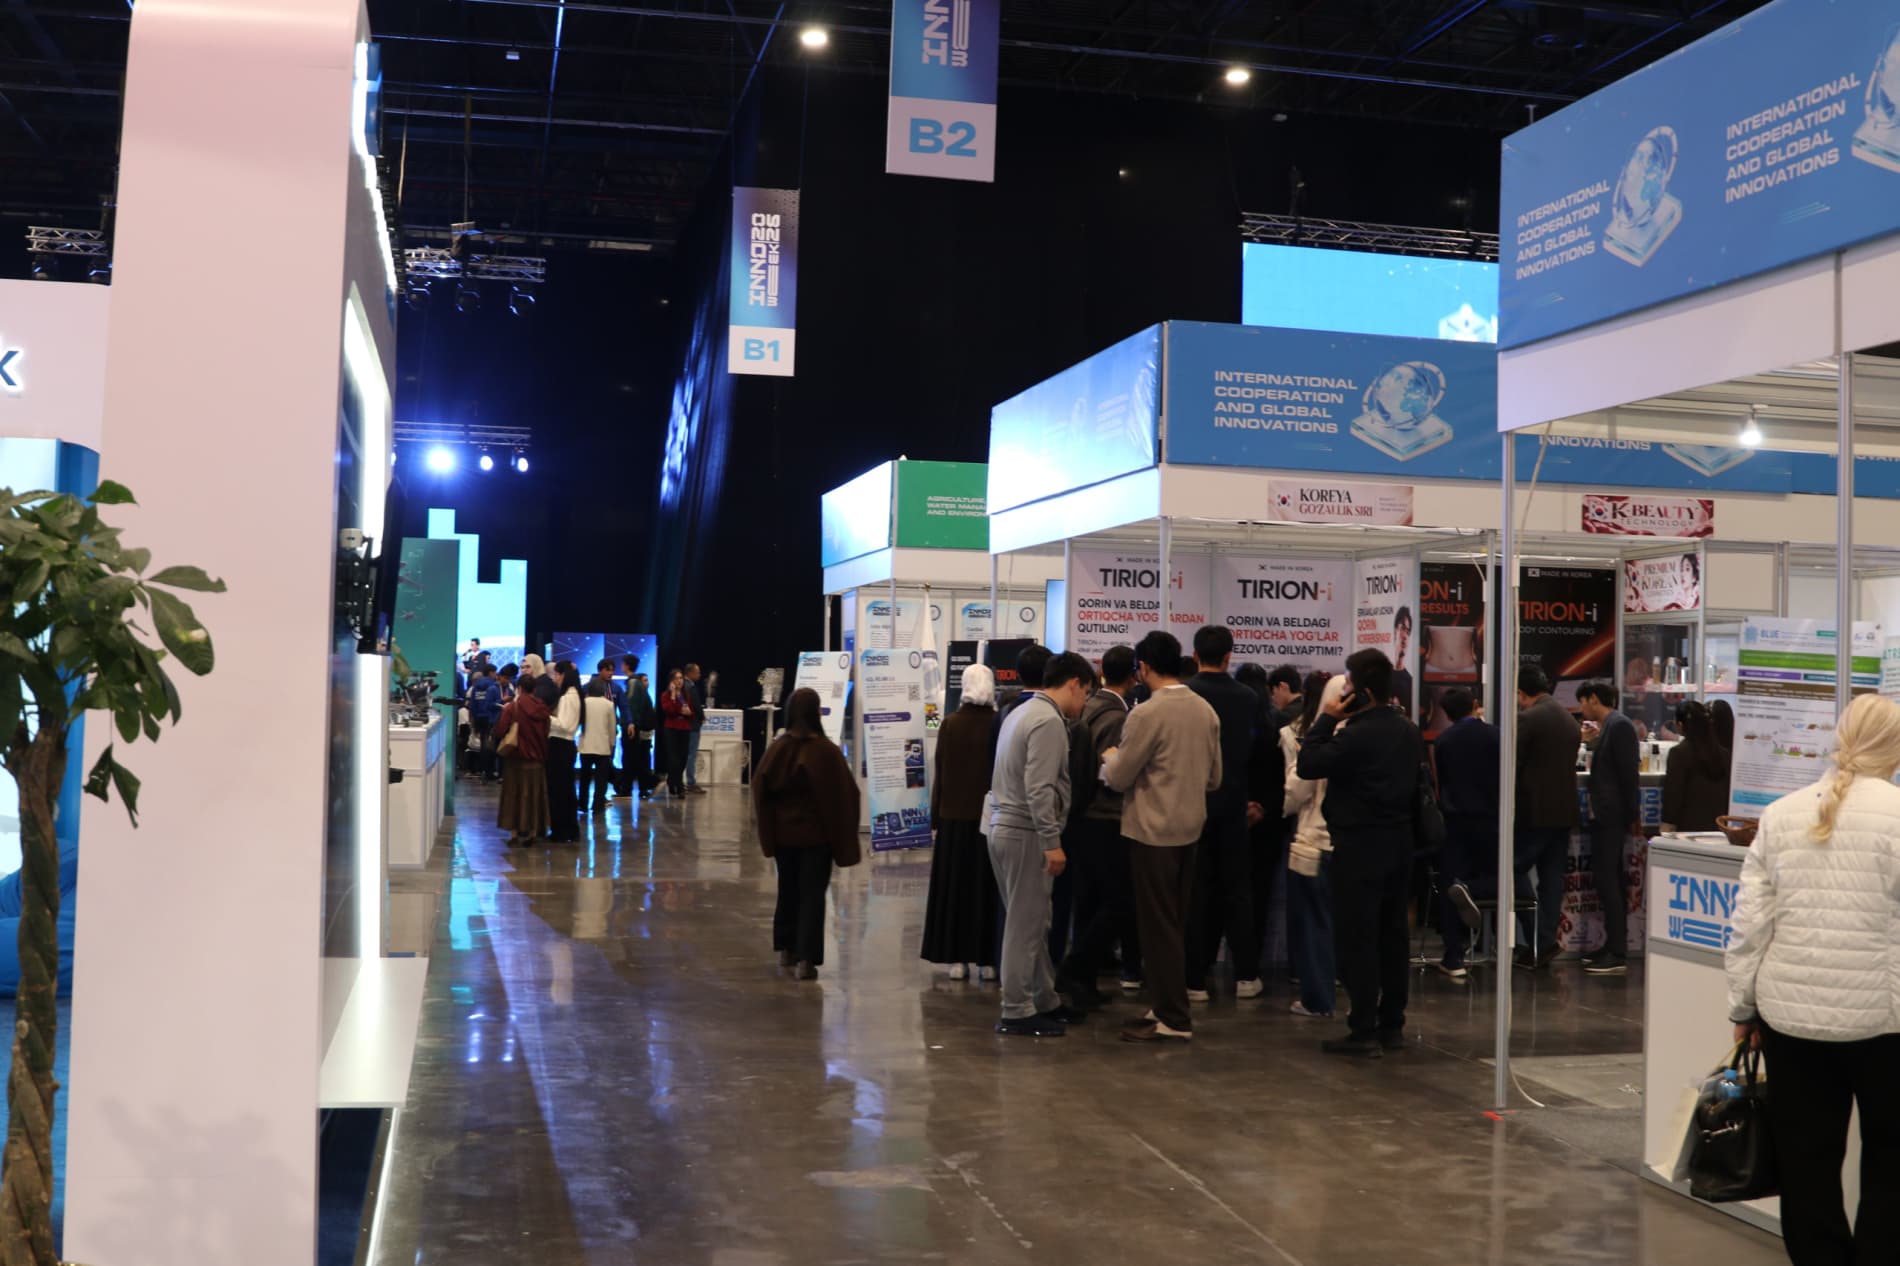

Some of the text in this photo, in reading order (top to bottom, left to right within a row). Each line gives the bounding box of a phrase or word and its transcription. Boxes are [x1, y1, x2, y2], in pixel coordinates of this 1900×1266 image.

[1727, 72, 1861, 140] INTERNATIONAL
[908, 117, 977, 158] B2
[1726, 99, 1846, 161] COOPERATION
[1726, 129, 1834, 182] AND GLOBAL
[1725, 147, 1839, 204] INNOVATIONS
[1517, 179, 1610, 228] INTERNATIONAL
[1518, 201, 1600, 245] COOPERATION
[1516, 224, 1592, 263] AND GLOBAL
[1516, 240, 1595, 280] INNOVATIONS
[744, 338, 780, 362] B1
[1214, 371, 1358, 390] INTERNATIONAL
[1214, 386, 1344, 404] COOPERATION
[1214, 401, 1332, 418] AND GLOBAL
[1214, 416, 1339, 434] INNOVATIONS
[1355, 506, 1373, 517] SIRI
[1612, 503, 1697, 520] K-BEAUTY
[1620, 518, 1694, 527] TECHNOLOGY
[1099, 568, 1182, 589] TIRIO-i
[1366, 574, 1402, 595] TIRION-i
[1237, 579, 1332, 601] TIRION-i
[1078, 599, 1172, 610] QORIN VA BELDAI
[1420, 603, 1470, 615] RESULTS
[1078, 611, 1134, 621] ORTIQCHA
[1226, 616, 1330, 628] QORIN VA BELDAGI
[1077, 623, 1129, 634] QUTILING!
[1538, 626, 1595, 635] CONTOURING
[1232, 644, 1343, 656] EZOVTA QILYAPTIMI?
